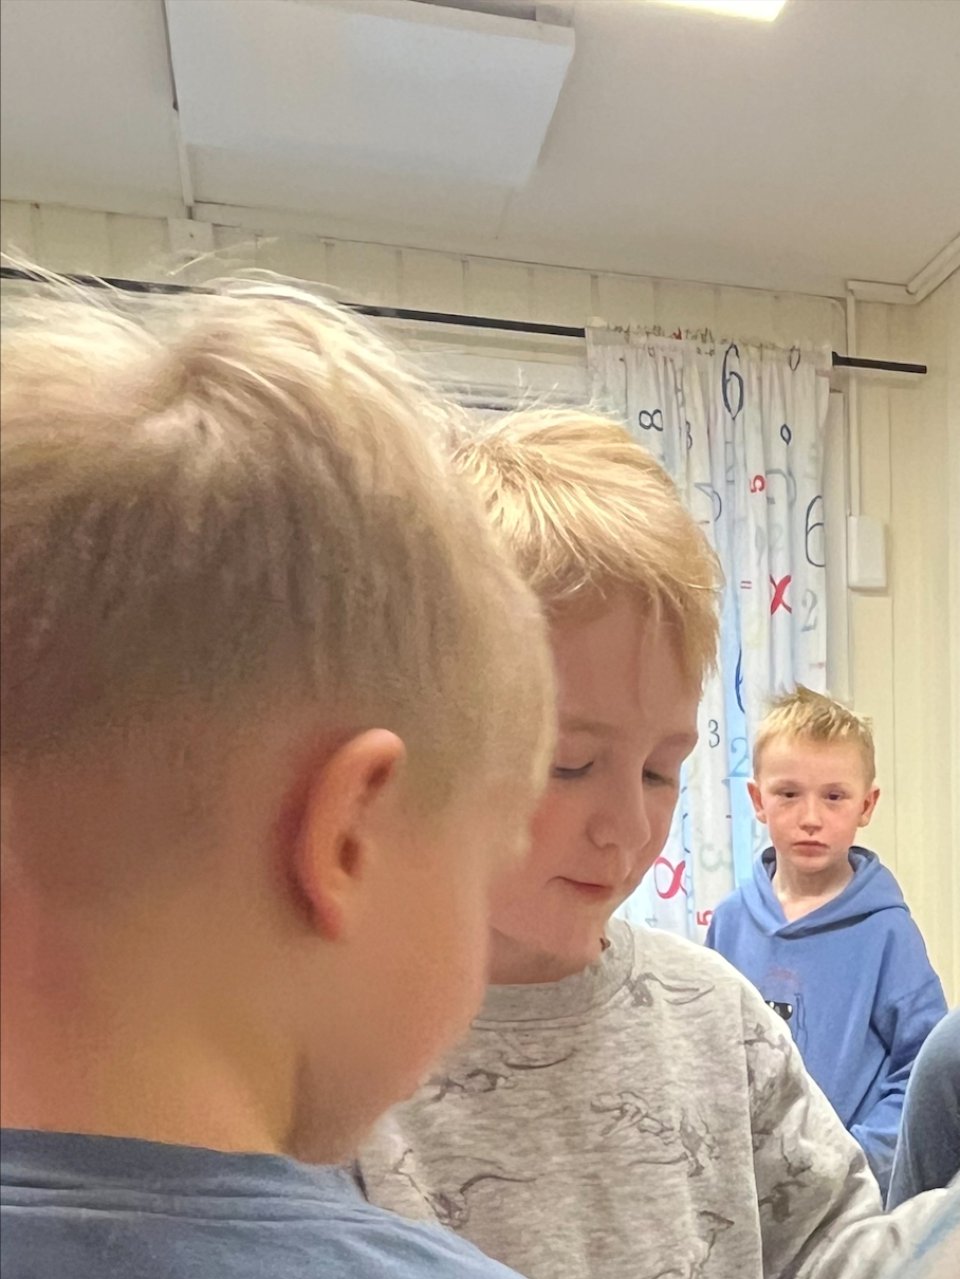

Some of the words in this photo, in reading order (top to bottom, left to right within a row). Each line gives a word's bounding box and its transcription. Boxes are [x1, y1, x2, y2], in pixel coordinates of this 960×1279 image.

[722, 343, 744, 420] 6
[708, 719, 720, 748] 3
[728, 737, 749, 777] 2
